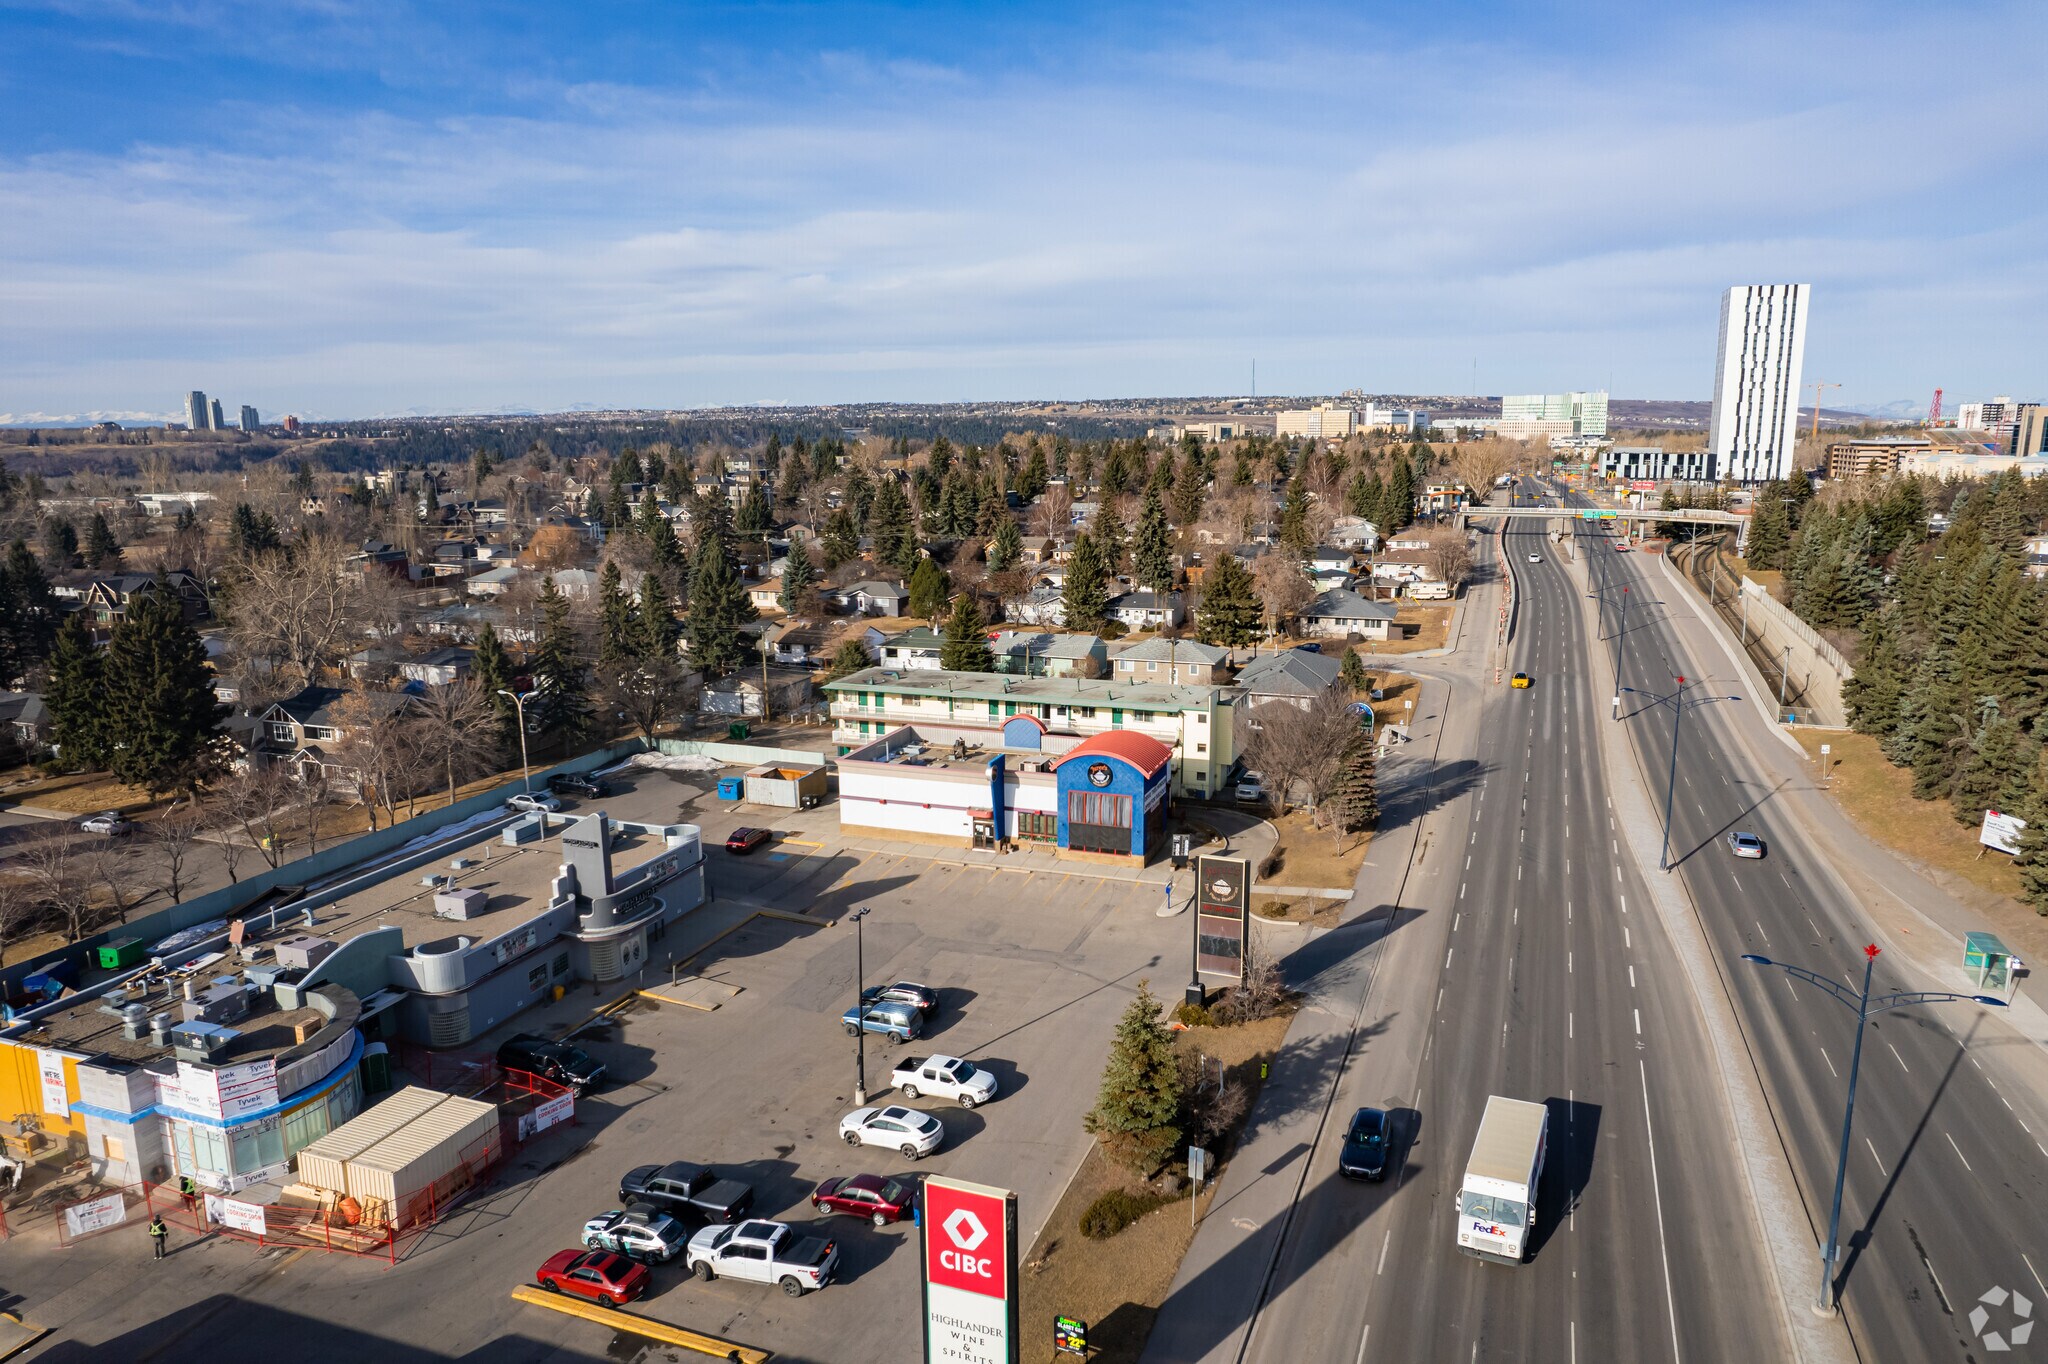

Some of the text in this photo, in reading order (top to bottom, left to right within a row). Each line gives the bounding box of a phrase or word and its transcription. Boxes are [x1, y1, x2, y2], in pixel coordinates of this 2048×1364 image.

[238, 1095, 261, 1106] Tyvek
[245, 1171, 268, 1183] Tyvek
[1473, 1221, 1506, 1238] FedEx
[940, 1250, 992, 1278] CIBC
[931, 1312, 1004, 1338] HIGHLANDER
[950, 1330, 985, 1346] WINE
[942, 1347, 993, 1364] SPIRITS
[962, 1343, 971, 1352] &
